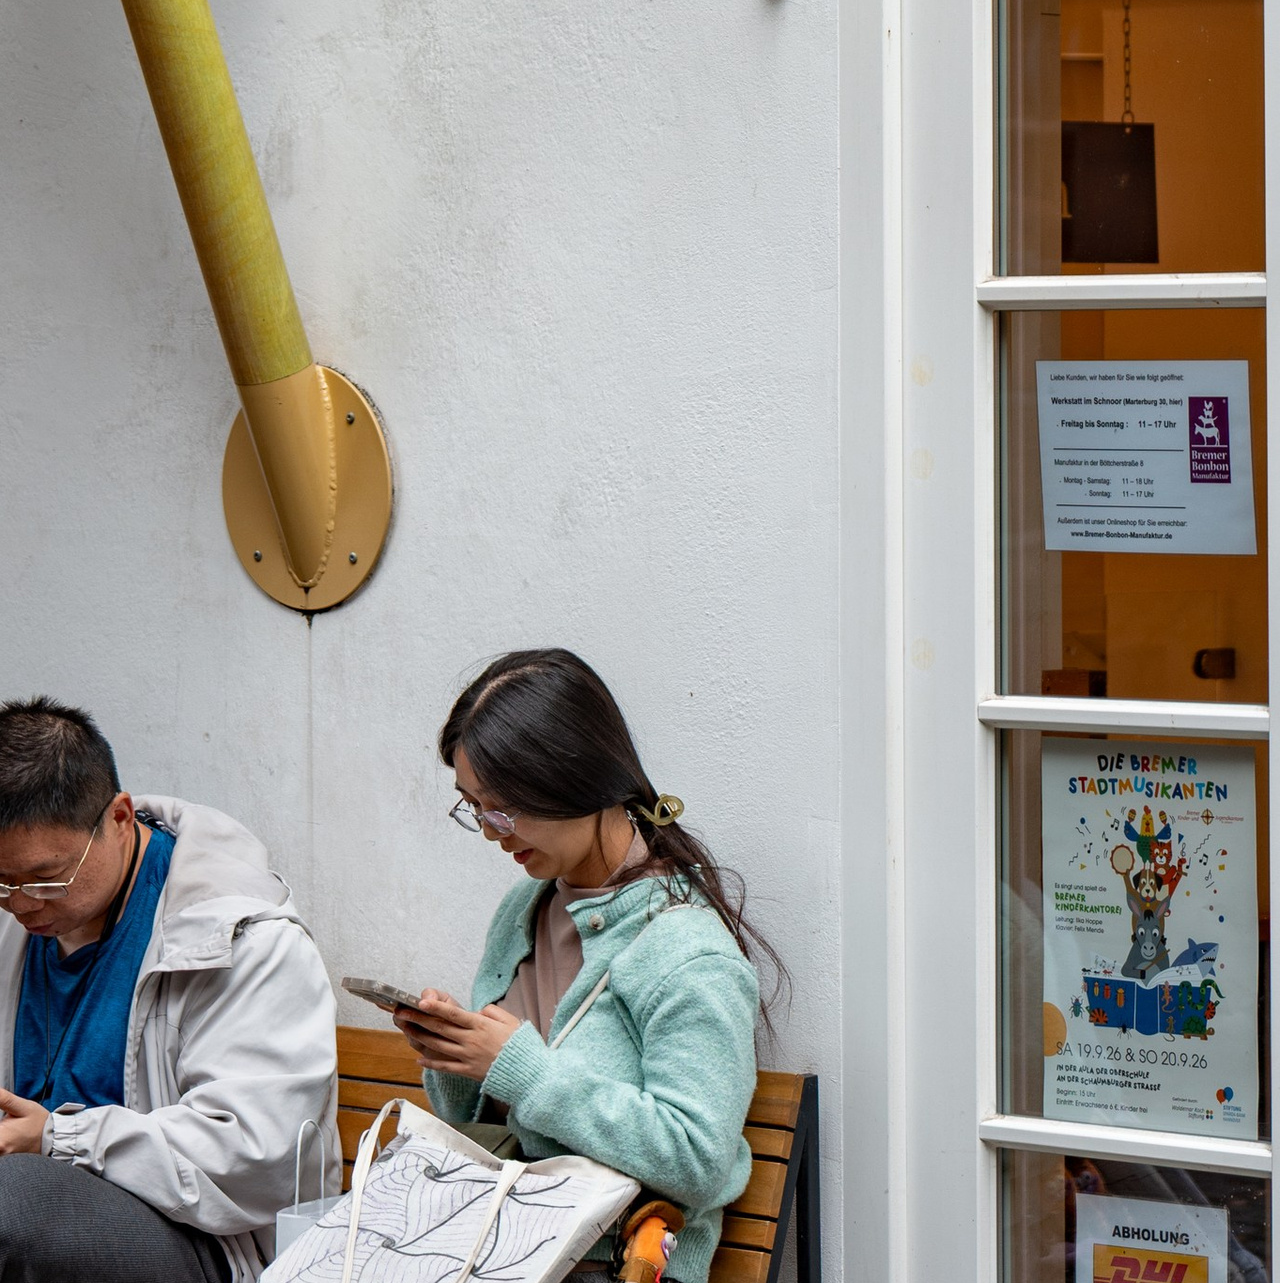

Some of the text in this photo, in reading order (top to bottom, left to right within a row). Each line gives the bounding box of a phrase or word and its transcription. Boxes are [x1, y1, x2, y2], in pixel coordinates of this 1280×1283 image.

[1123, 398, 1157, 406] (Marterburg
[1061, 420, 1083, 429] Freitag
[1097, 420, 1124, 430] Sonntag
[1192, 450, 1227, 460] Bremer
[1192, 461, 1229, 471] Bonbon
[1087, 477, 1111, 486] Samstag:
[1089, 490, 1112, 498] Sonntag:
[1107, 518, 1137, 526] Onlineshop
[1071, 531, 1172, 539] www.Bremer-Bonbon-Manufaktur.de
[1097, 752, 1197, 775] DIE BREMER
[1068, 775, 1228, 802] STADTMUSIKANTEN
[1055, 892, 1086, 902] BREMER
[1055, 903, 1122, 915] KINDERKANTOREI
[1056, 1041, 1208, 1069] SA 19.9.26 & SO 20.9.26
[1079, 1065, 1094, 1074] AULA
[1109, 1068, 1150, 1079] OBERSCHULE
[1081, 1077, 1132, 1088] SCHAUMBURGER
[1133, 1082, 1161, 1091] STRASSE
[1056, 1088, 1077, 1096] Beginn:
[1075, 1100, 1108, 1110] Erwachsene
[1112, 1225, 1190, 1245] ABHOLUNG
